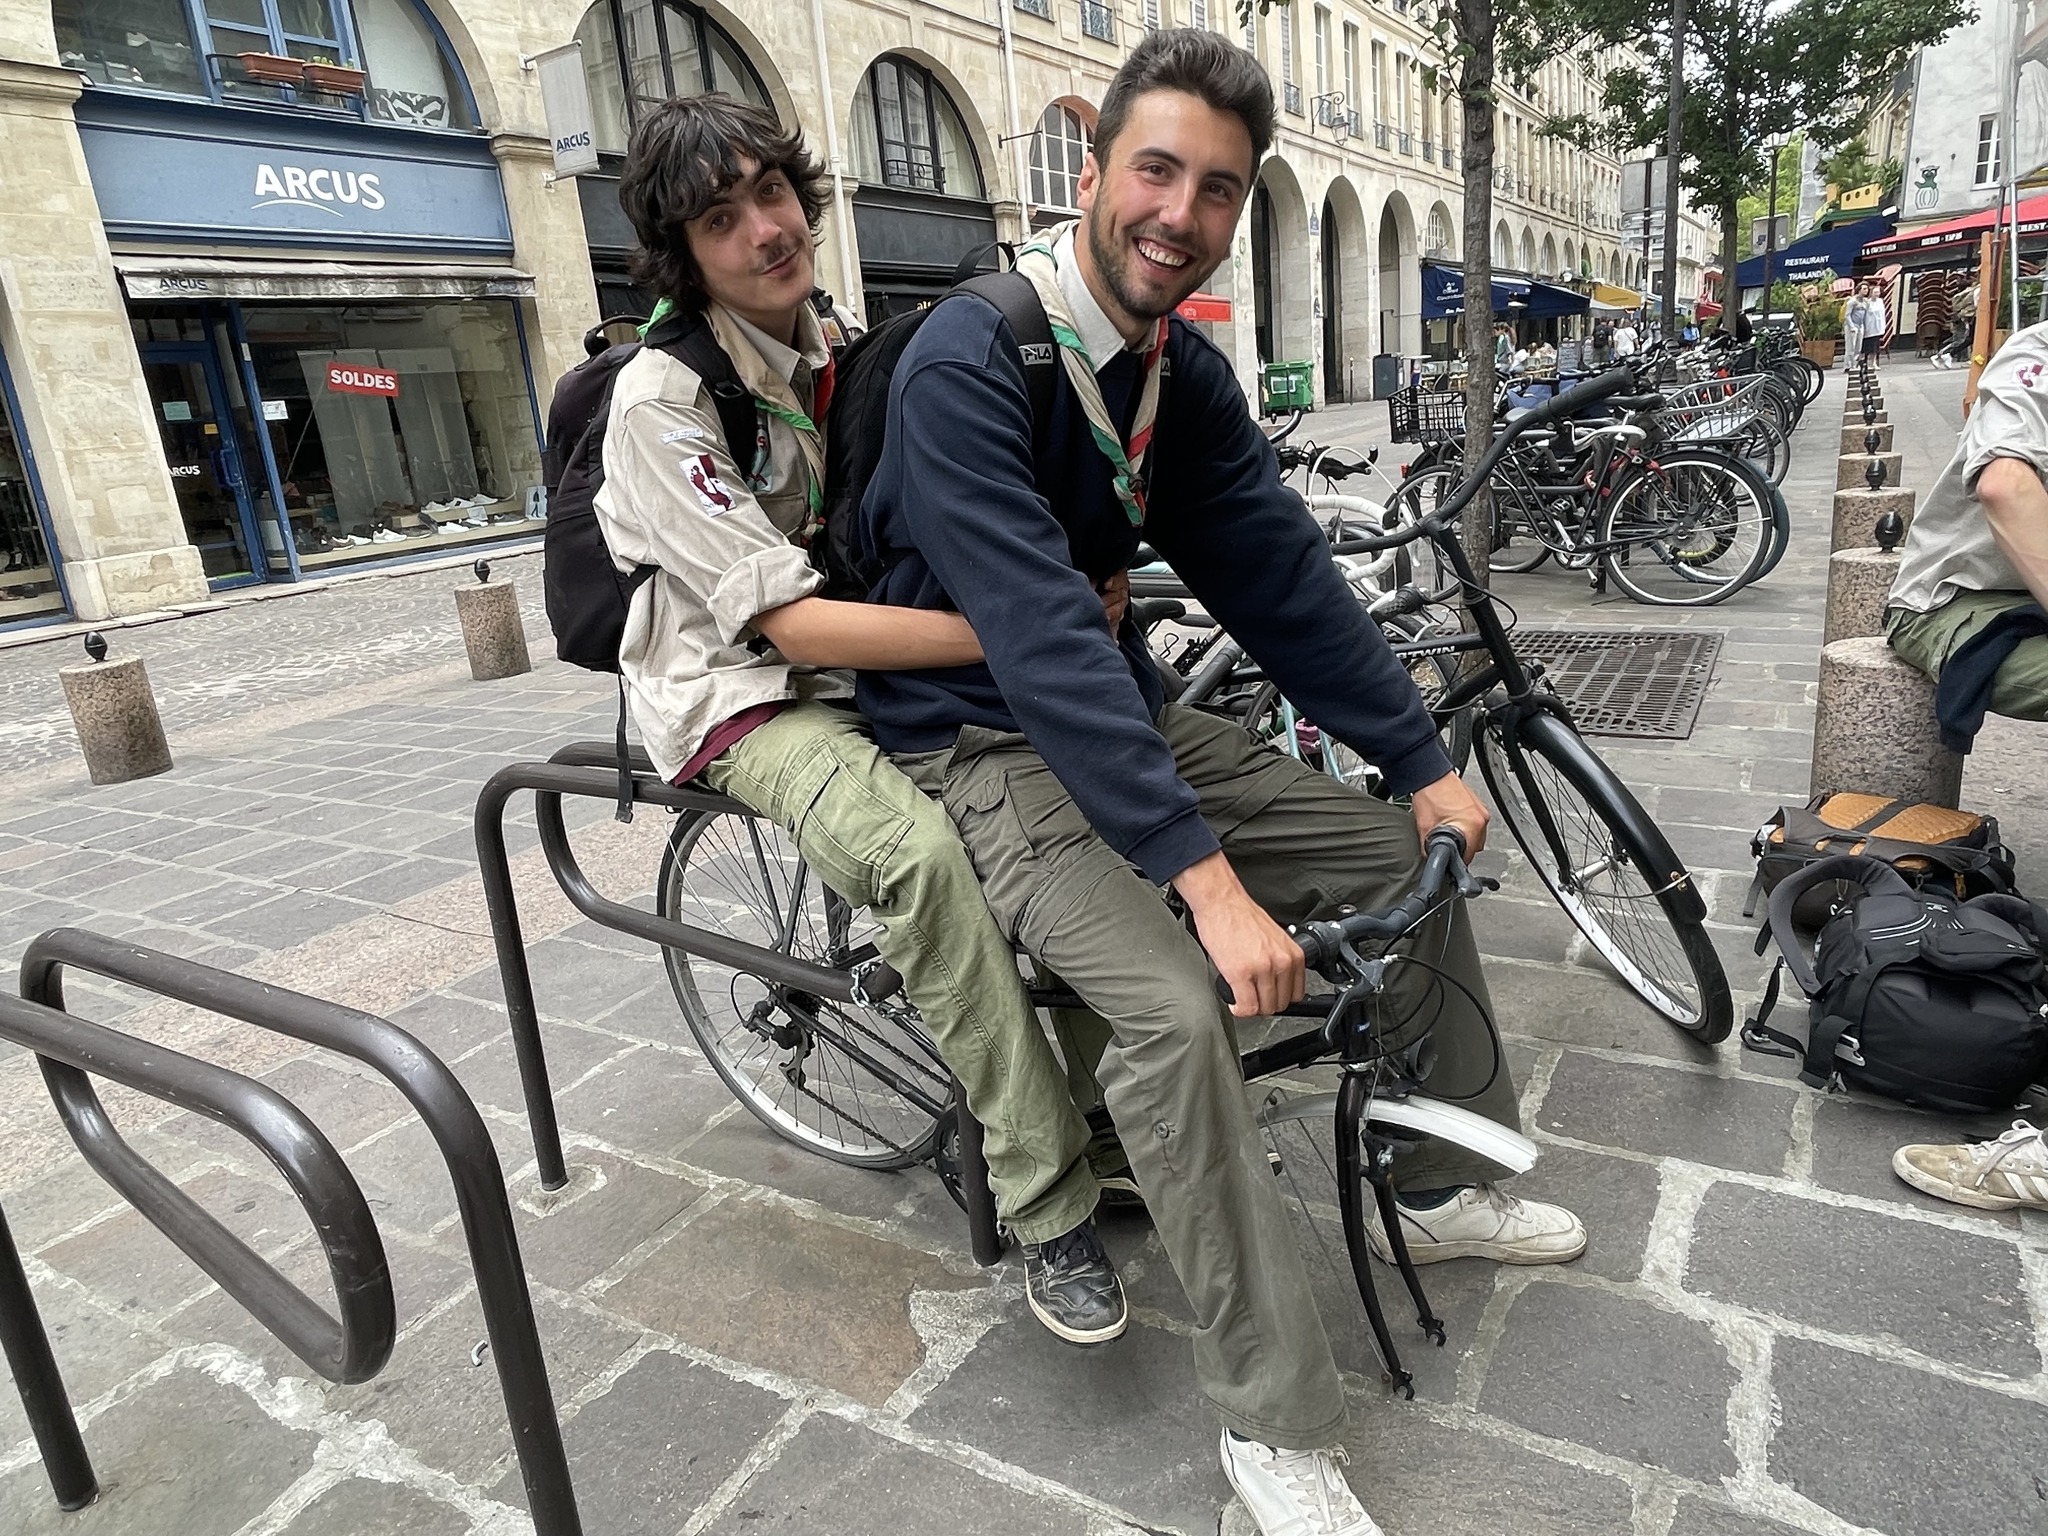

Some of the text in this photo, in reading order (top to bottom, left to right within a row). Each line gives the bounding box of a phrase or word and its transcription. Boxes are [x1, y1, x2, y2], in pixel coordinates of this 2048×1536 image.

[557, 131, 590, 152] ARCUS
[254, 163, 386, 211] ARCUS
[1784, 255, 1830, 267] RESTAURANT
[1788, 269, 1826, 281] THAILANDA
[159, 278, 207, 291] ARCUS
[1024, 346, 1052, 362] FILA
[330, 369, 396, 390] SOLDES
